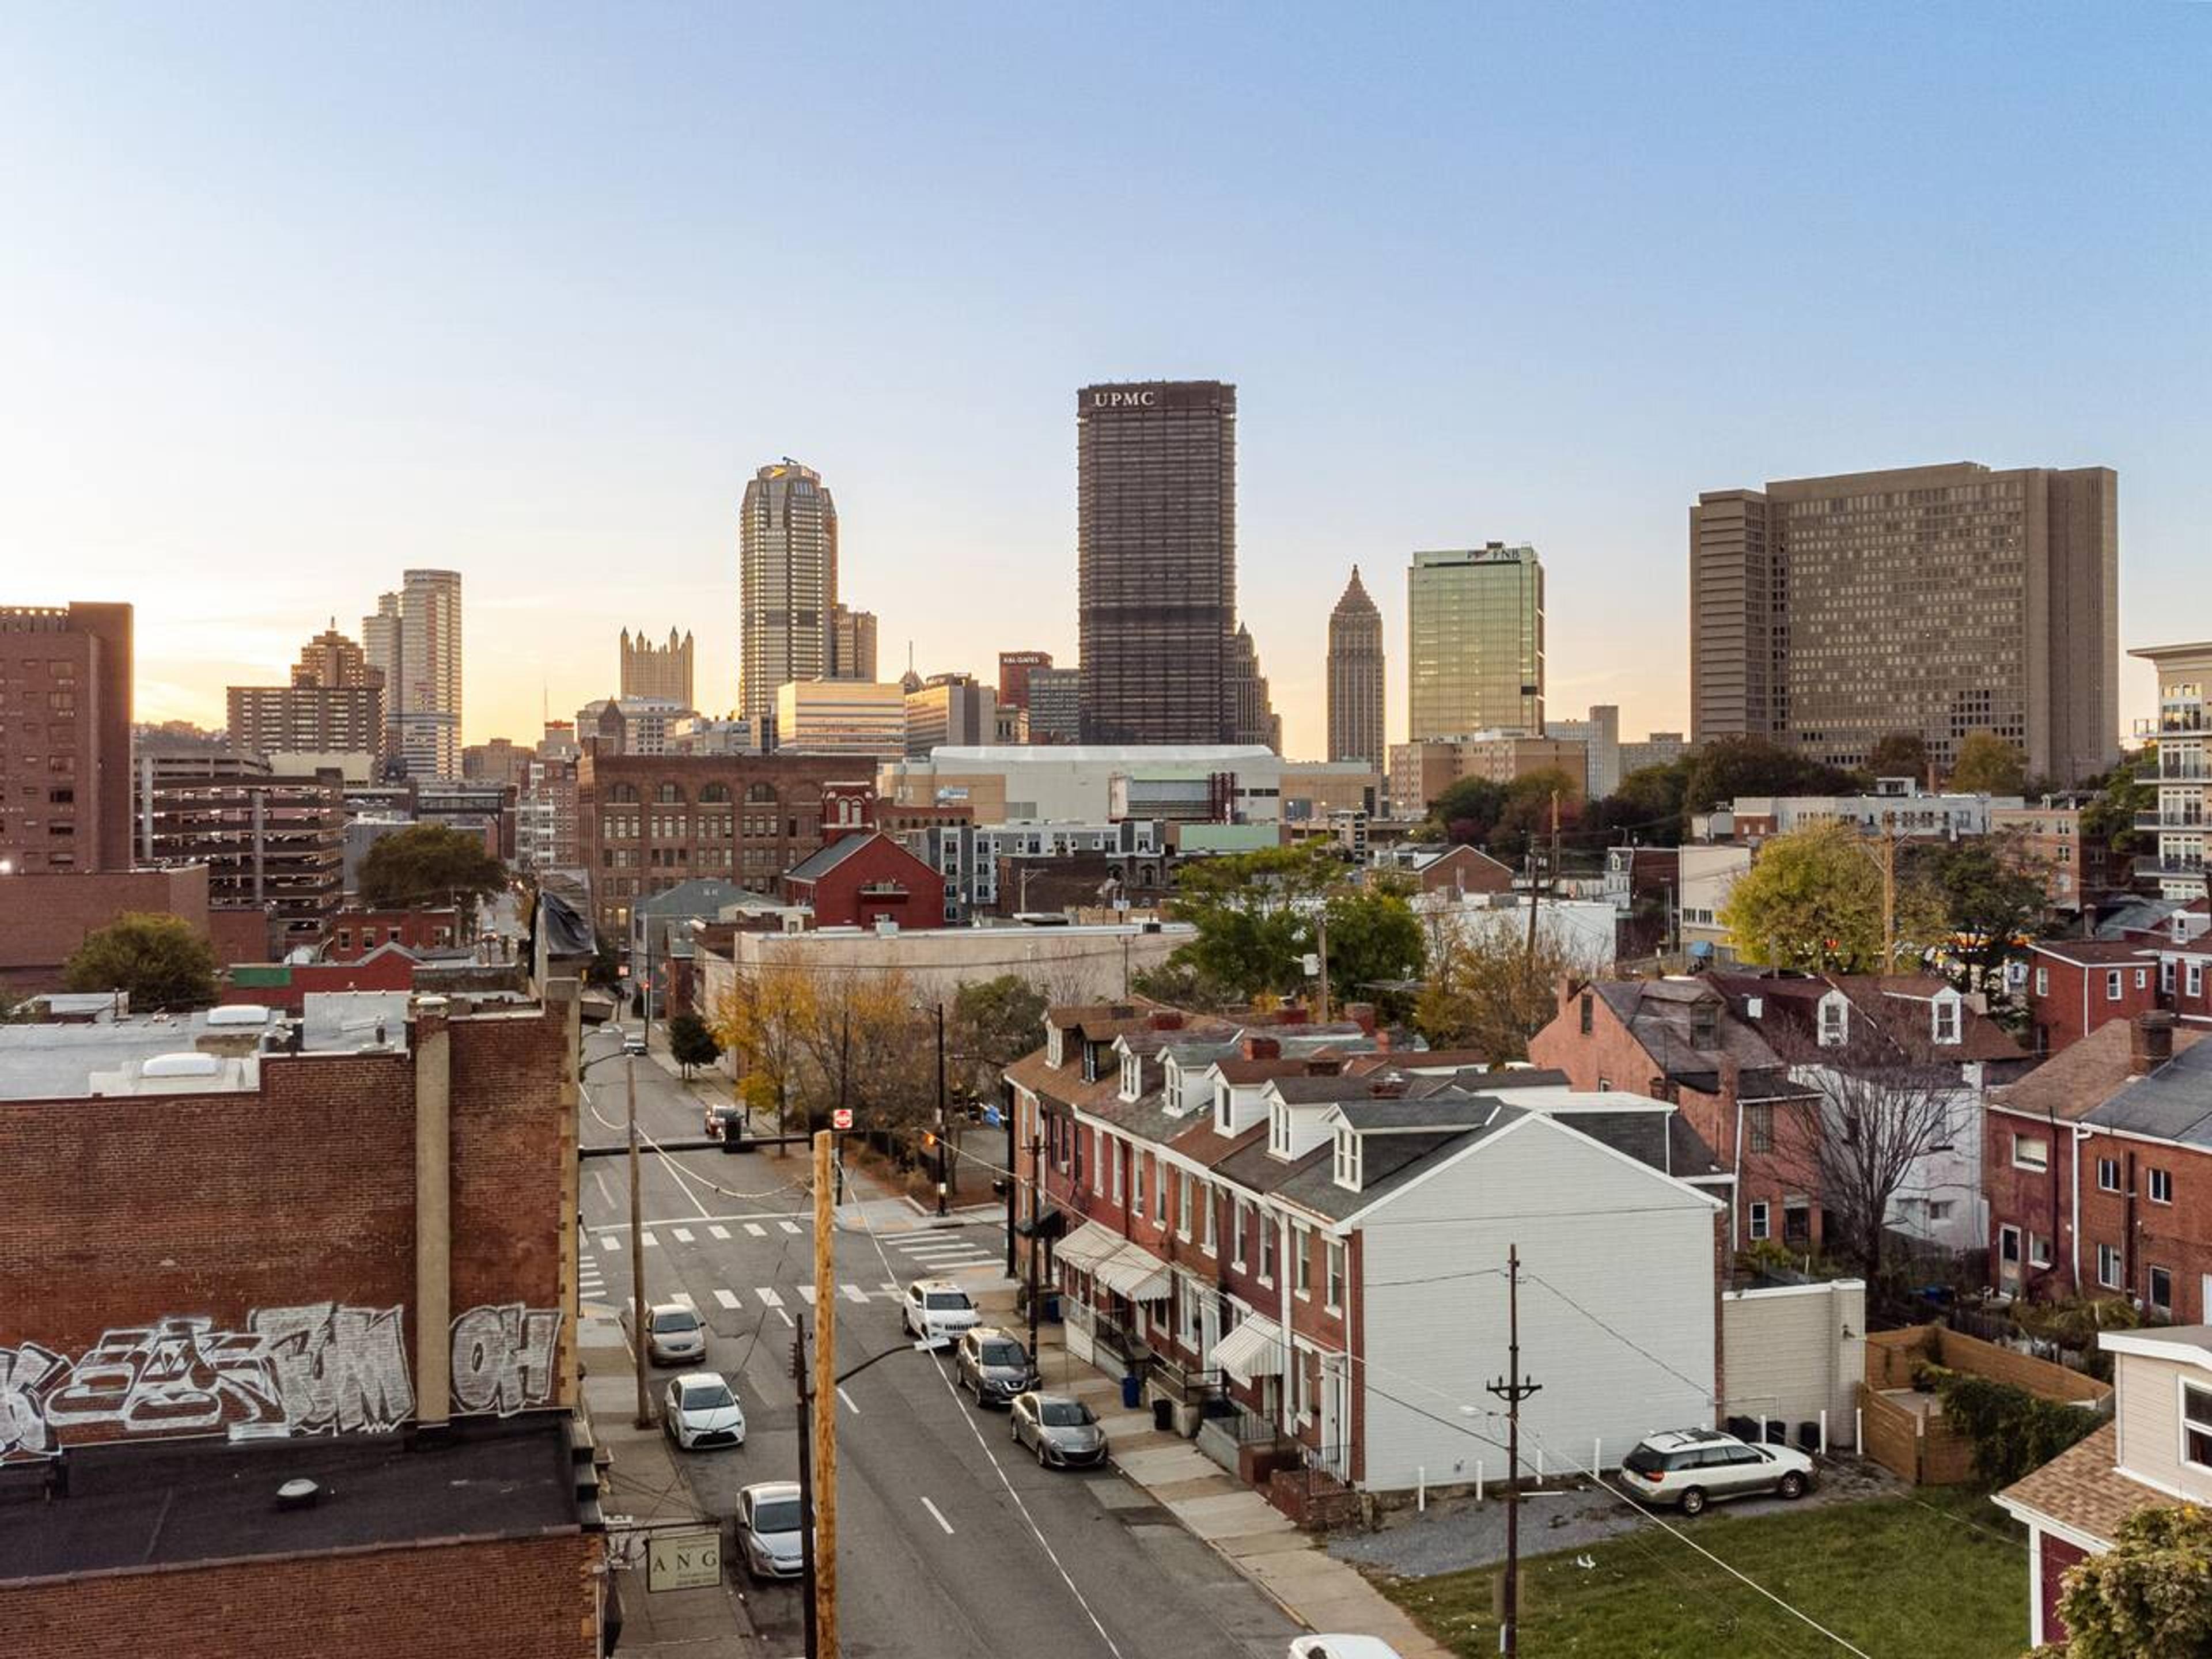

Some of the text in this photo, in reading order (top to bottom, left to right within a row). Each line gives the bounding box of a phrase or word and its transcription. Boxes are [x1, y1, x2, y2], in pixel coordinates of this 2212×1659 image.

[1094, 392, 1155, 407] UPMC
[1493, 548, 1520, 559] FNB
[653, 1550, 718, 1573] ANG
